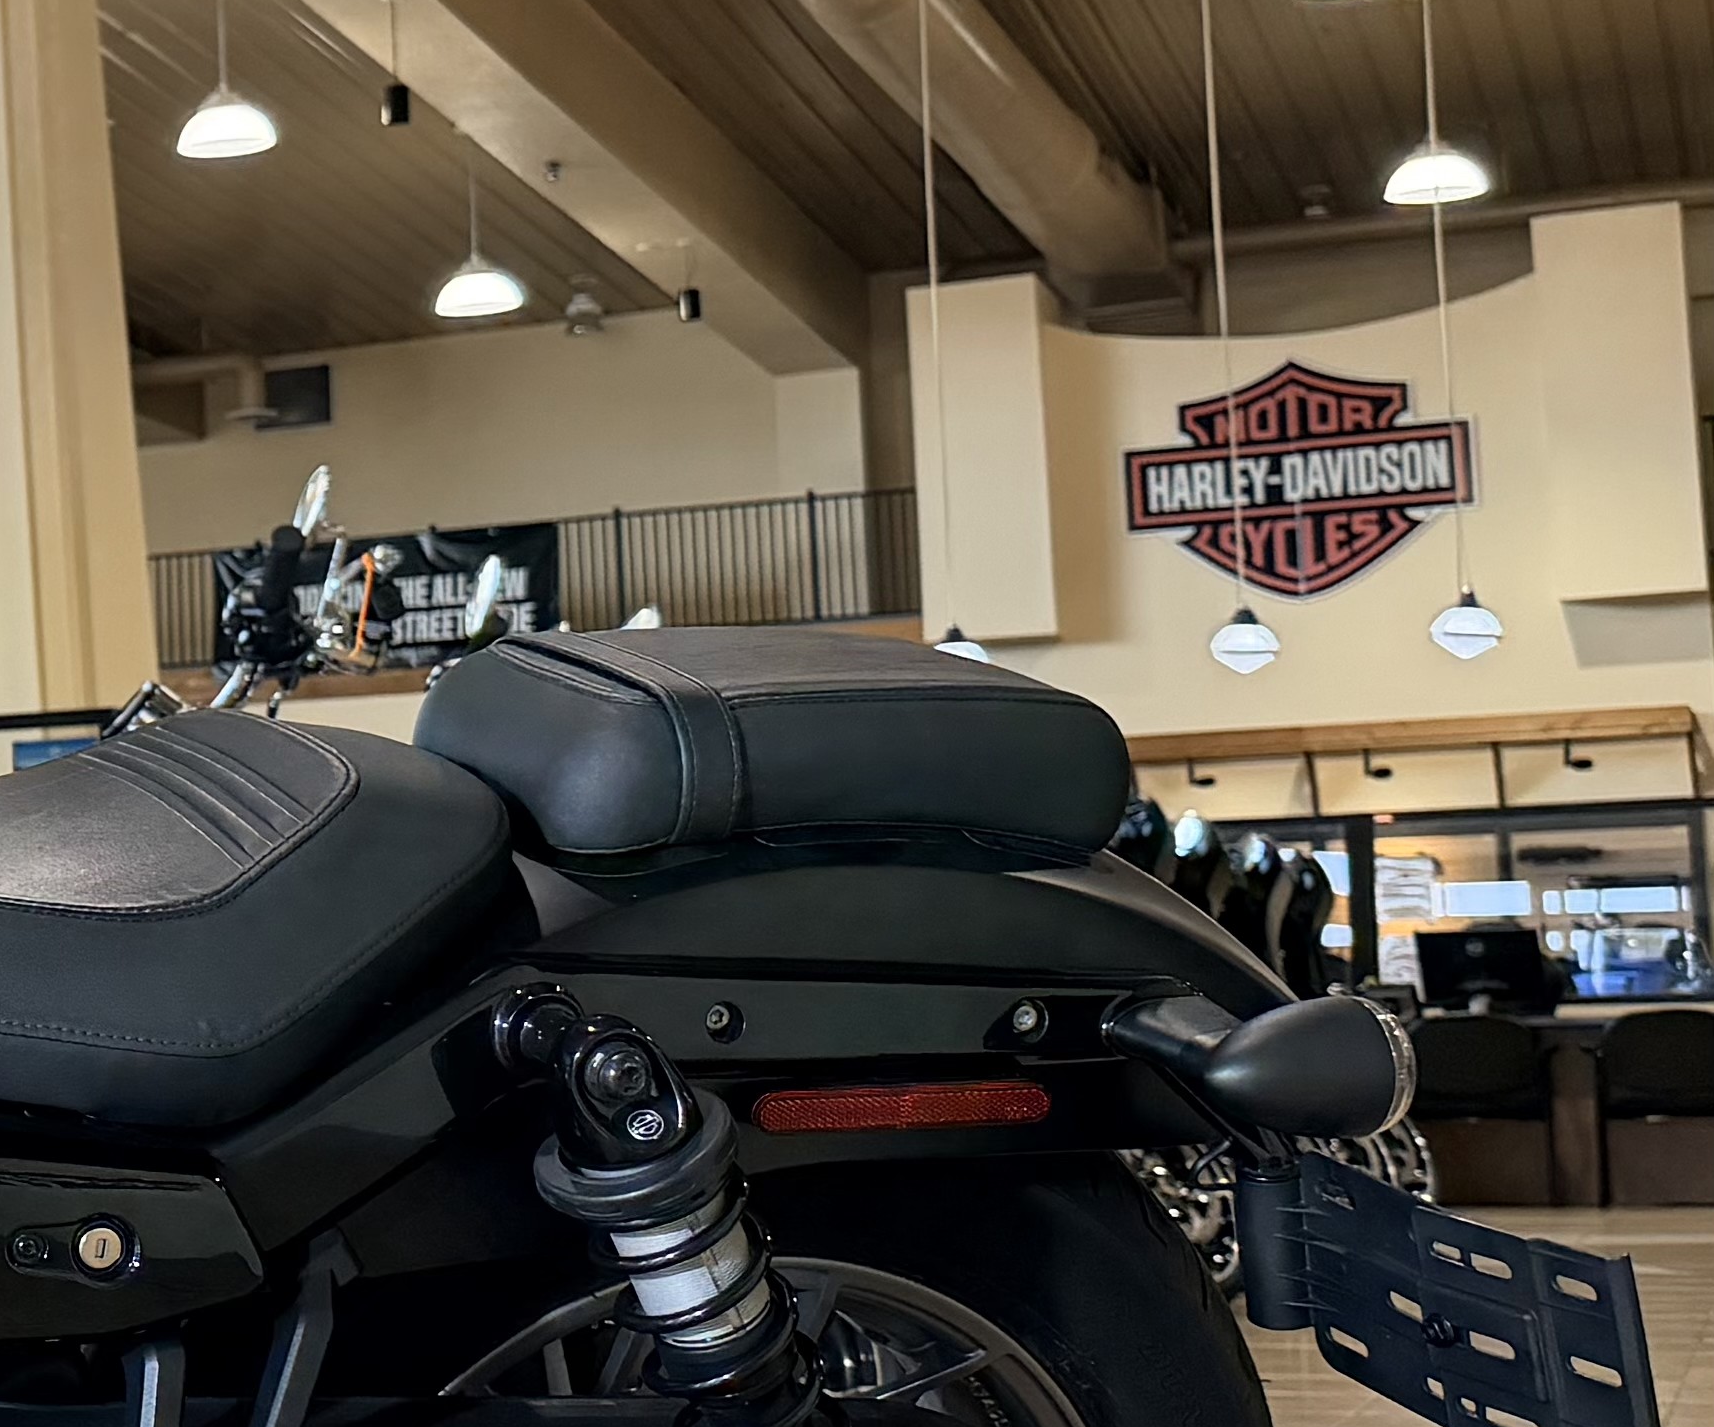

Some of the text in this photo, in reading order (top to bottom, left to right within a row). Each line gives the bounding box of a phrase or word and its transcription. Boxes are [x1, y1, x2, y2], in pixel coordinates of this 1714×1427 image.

[1216, 388, 1374, 445] MOTOR
[1146, 438, 1451, 514] HARLEY-DAVIDSON
[1219, 512, 1381, 579] CYCLES
